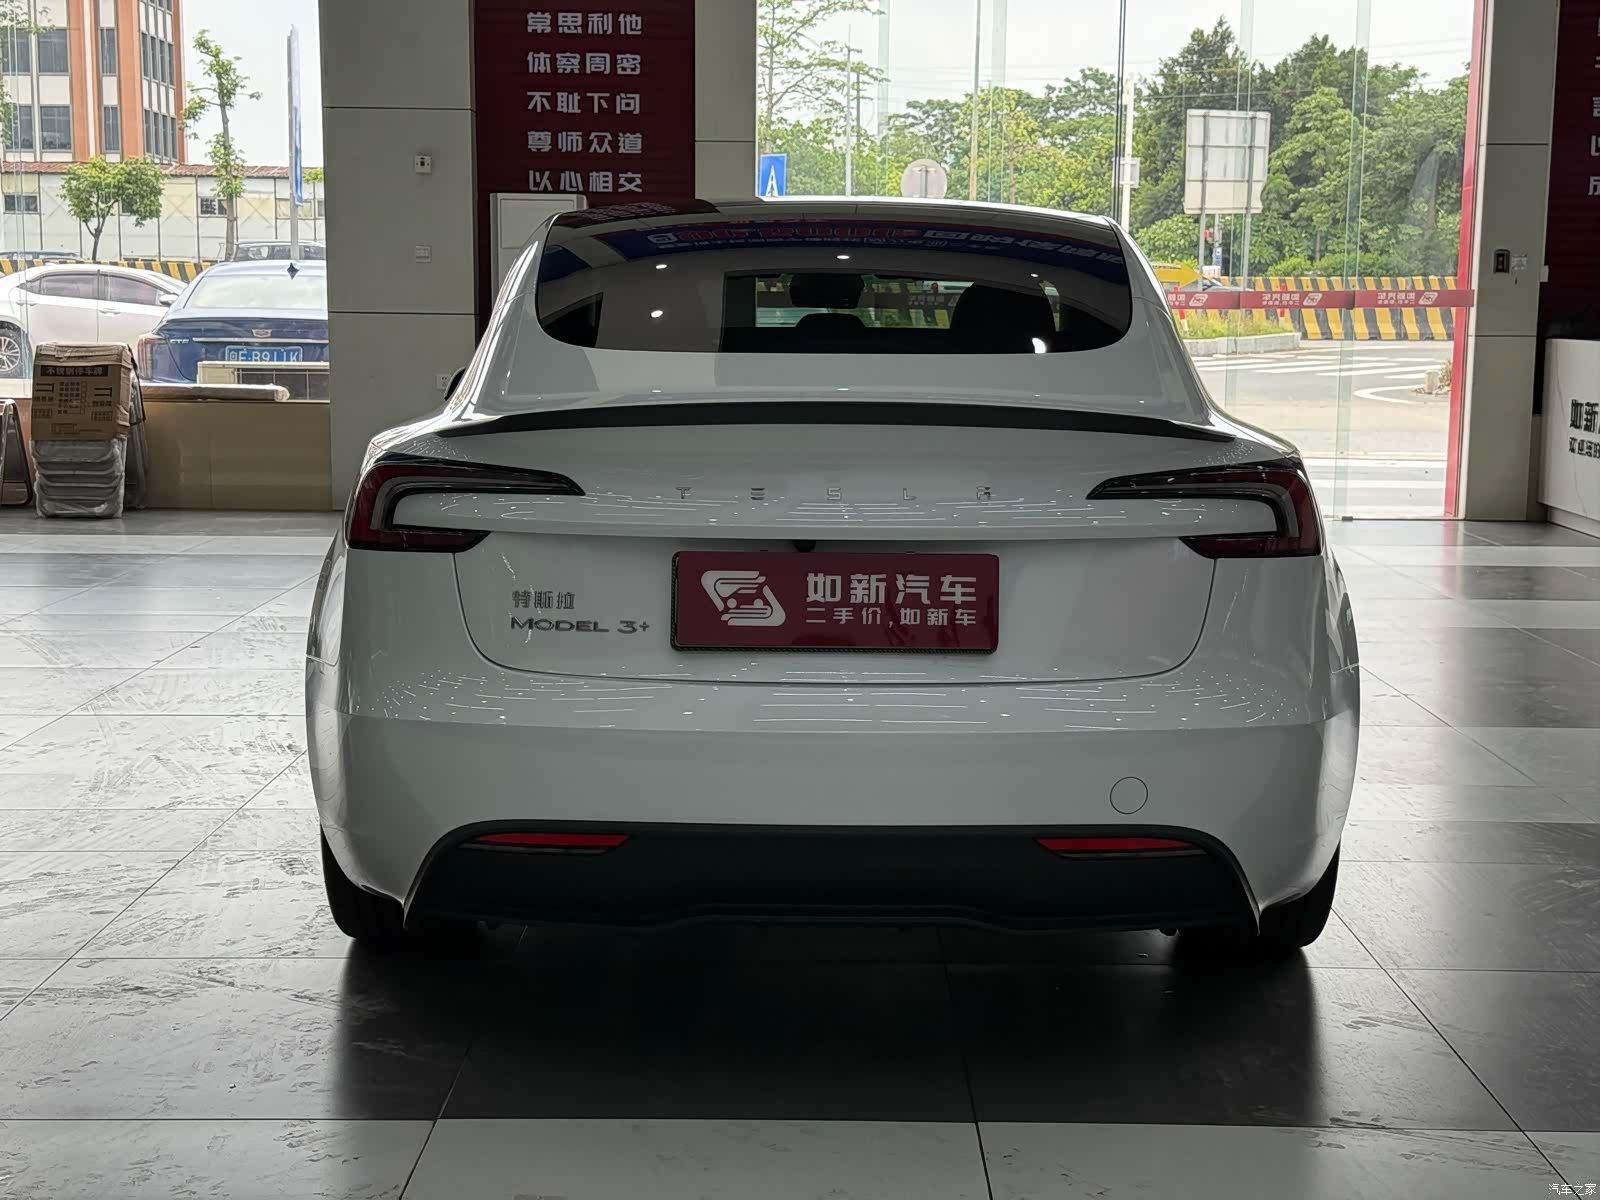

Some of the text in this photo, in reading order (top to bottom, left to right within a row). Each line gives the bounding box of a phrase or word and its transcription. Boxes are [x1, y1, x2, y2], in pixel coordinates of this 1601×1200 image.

[527, 12, 642, 35] 常思利他
[527, 52, 641, 75] 体察周密
[527, 92, 641, 114] 不耻下问
[527, 131, 642, 154] 尊师众道
[528, 170, 642, 193] 以心相交
[1569, 399, 1601, 434] 如新
[676, 487, 992, 500] TESLA
[512, 590, 576, 610] 特斯拉
[806, 573, 977, 605] 如新汽车
[510, 616, 650, 634] MODEL 3+
